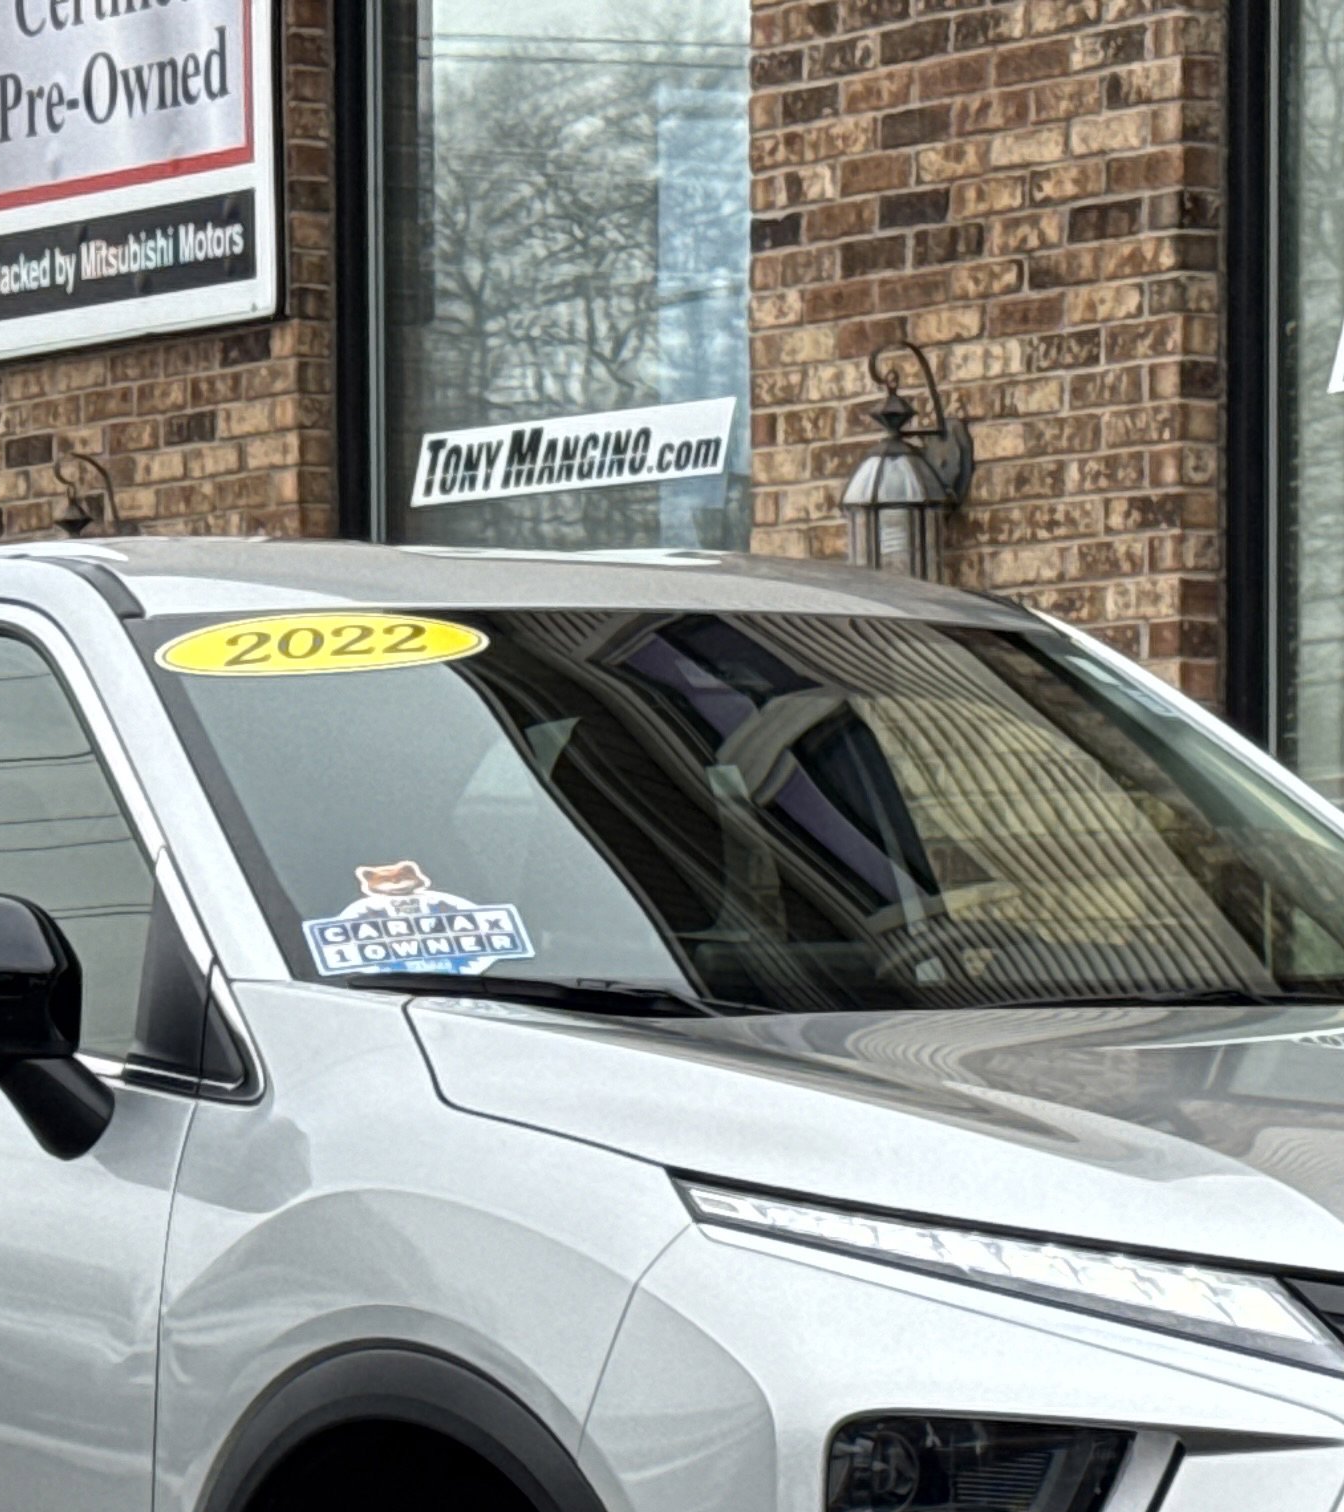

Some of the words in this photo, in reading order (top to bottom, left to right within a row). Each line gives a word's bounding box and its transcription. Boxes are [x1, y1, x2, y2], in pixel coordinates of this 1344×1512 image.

[55, 247, 77, 295] by
[80, 226, 174, 281] Mitsubishi
[179, 221, 244, 263] Motors
[224, 623, 427, 667] 2022
[323, 915, 504, 944] CARFAX
